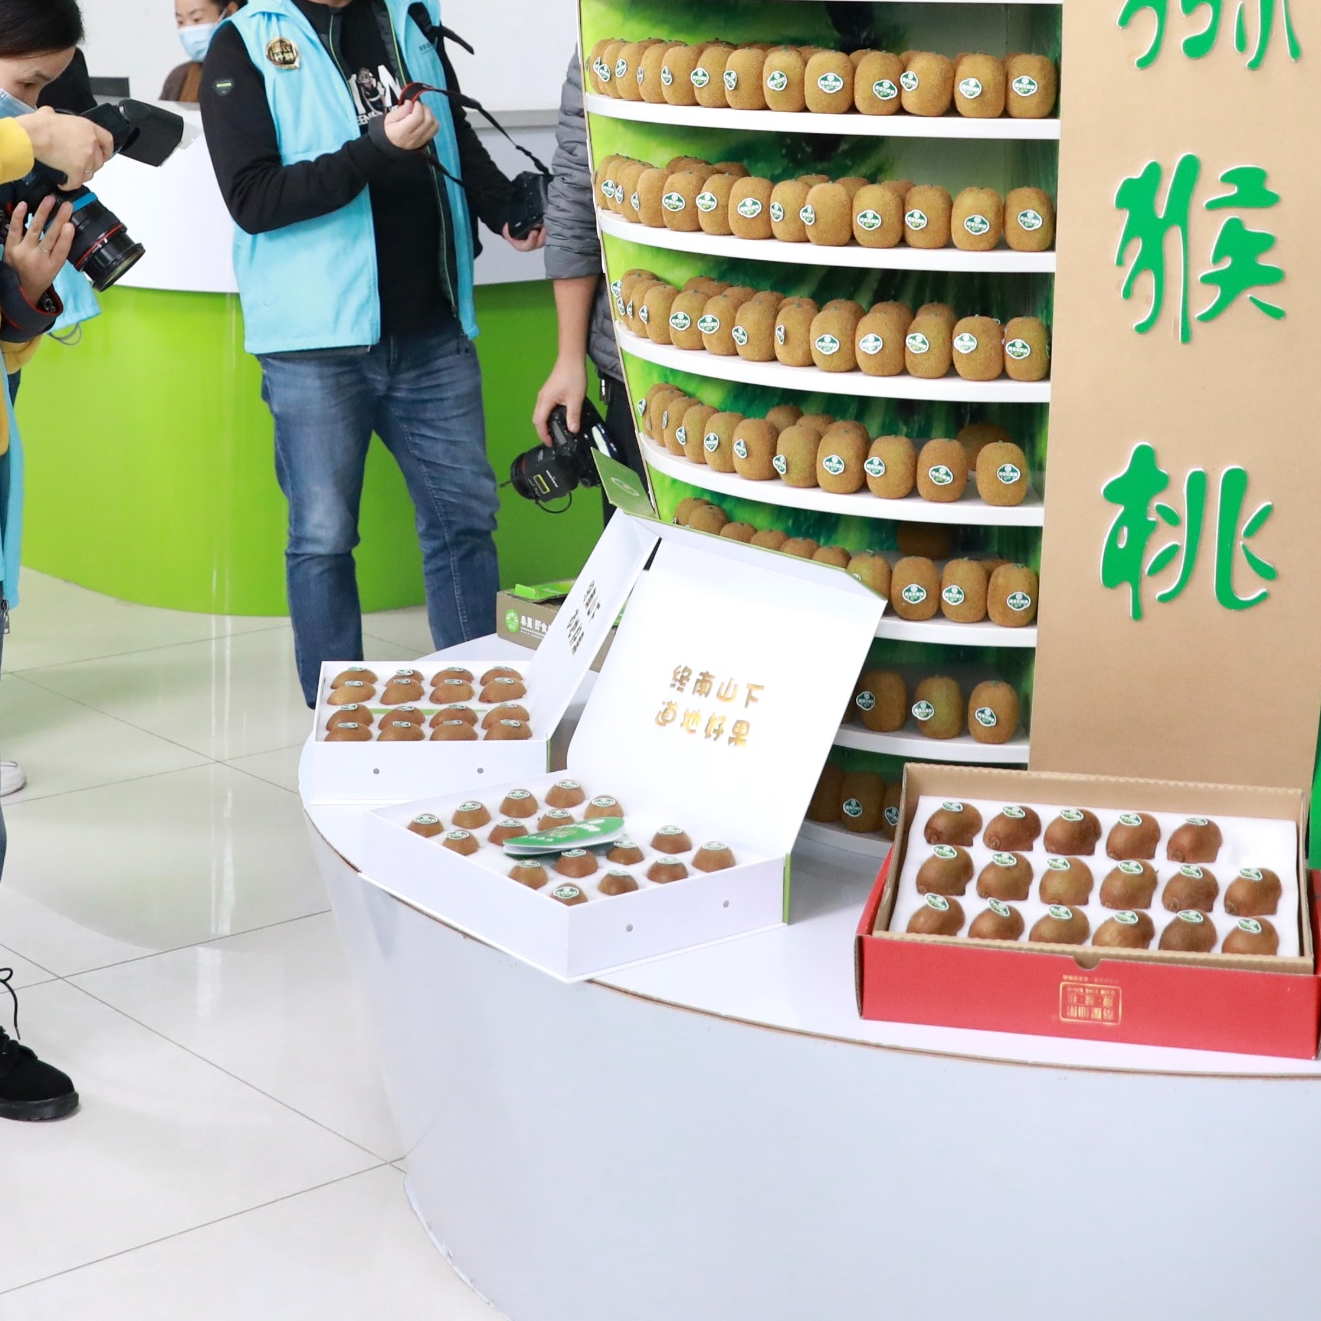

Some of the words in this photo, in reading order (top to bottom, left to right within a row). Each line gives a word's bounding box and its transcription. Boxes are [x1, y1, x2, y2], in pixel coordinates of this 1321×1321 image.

[669, 664, 765, 709] 终南山下
[654, 700, 751, 748] 道地好果
